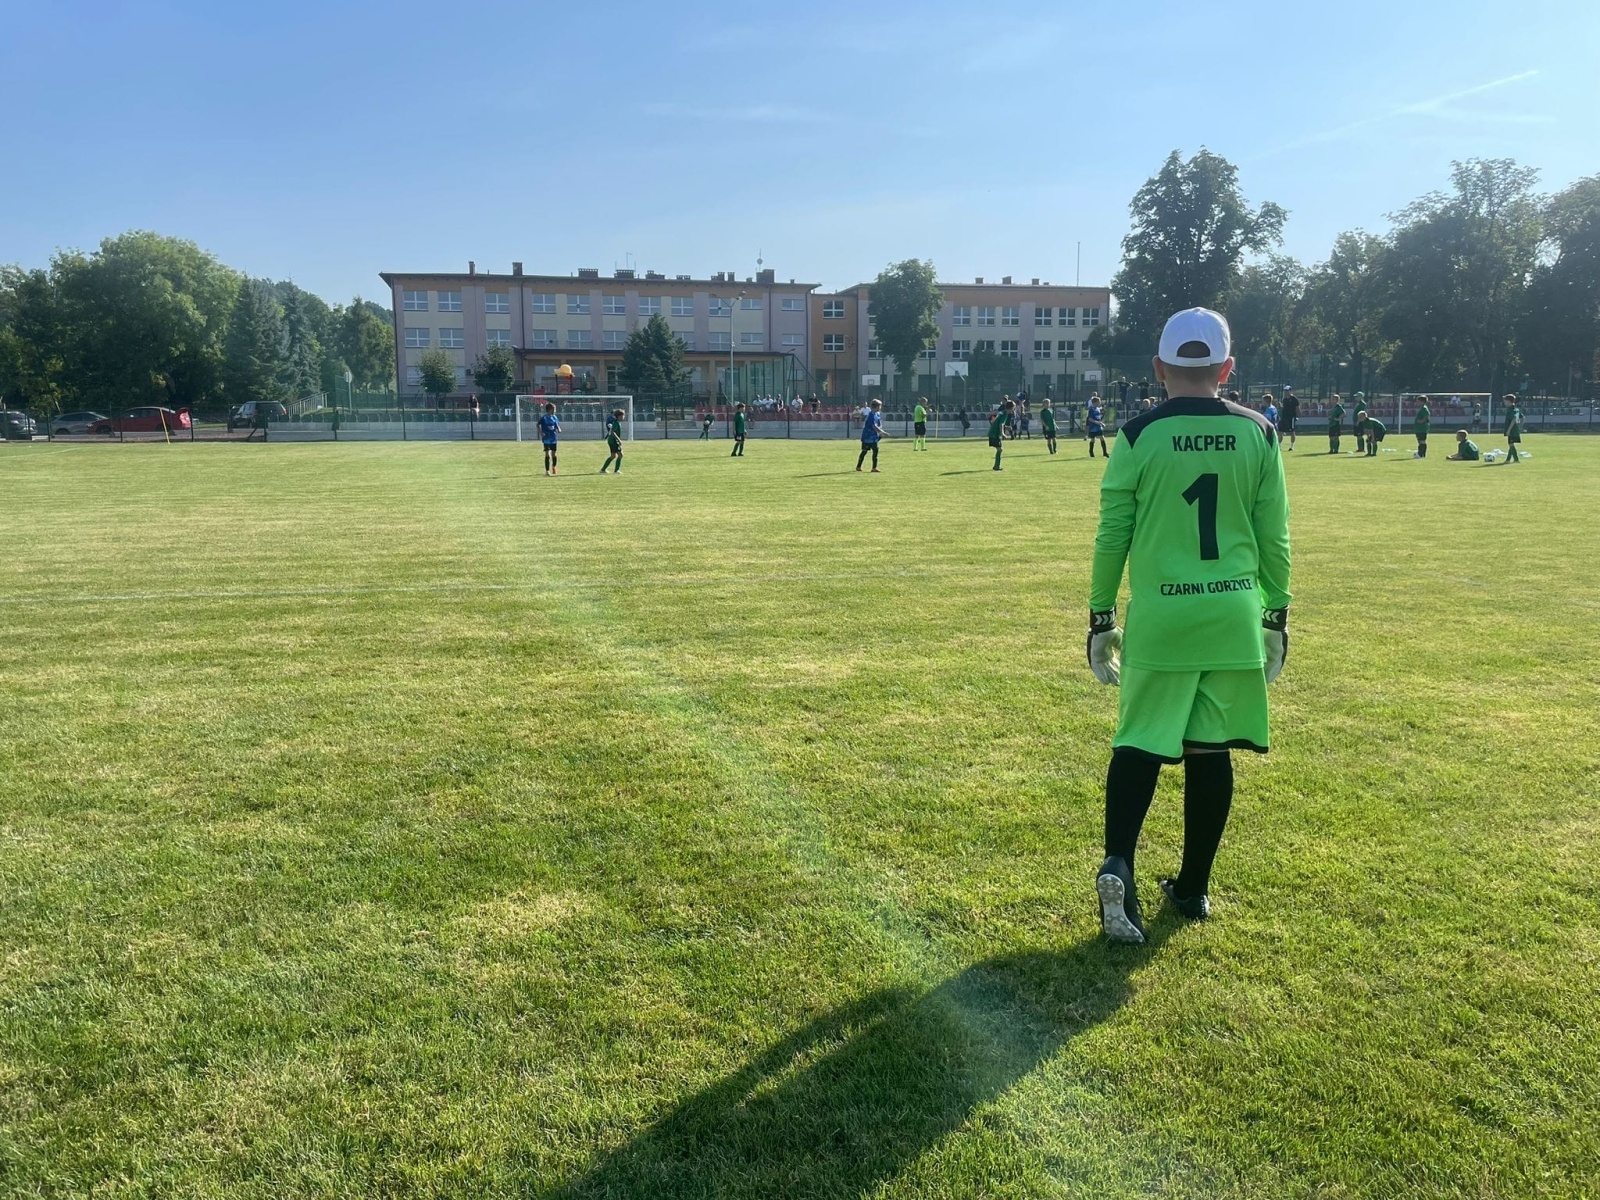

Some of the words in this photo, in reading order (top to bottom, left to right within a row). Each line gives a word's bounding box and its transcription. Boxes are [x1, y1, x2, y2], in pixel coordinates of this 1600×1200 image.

[1172, 435, 1236, 451] KACPER
[1182, 473, 1219, 560] 1
[1160, 583, 1205, 596] CZARNI
